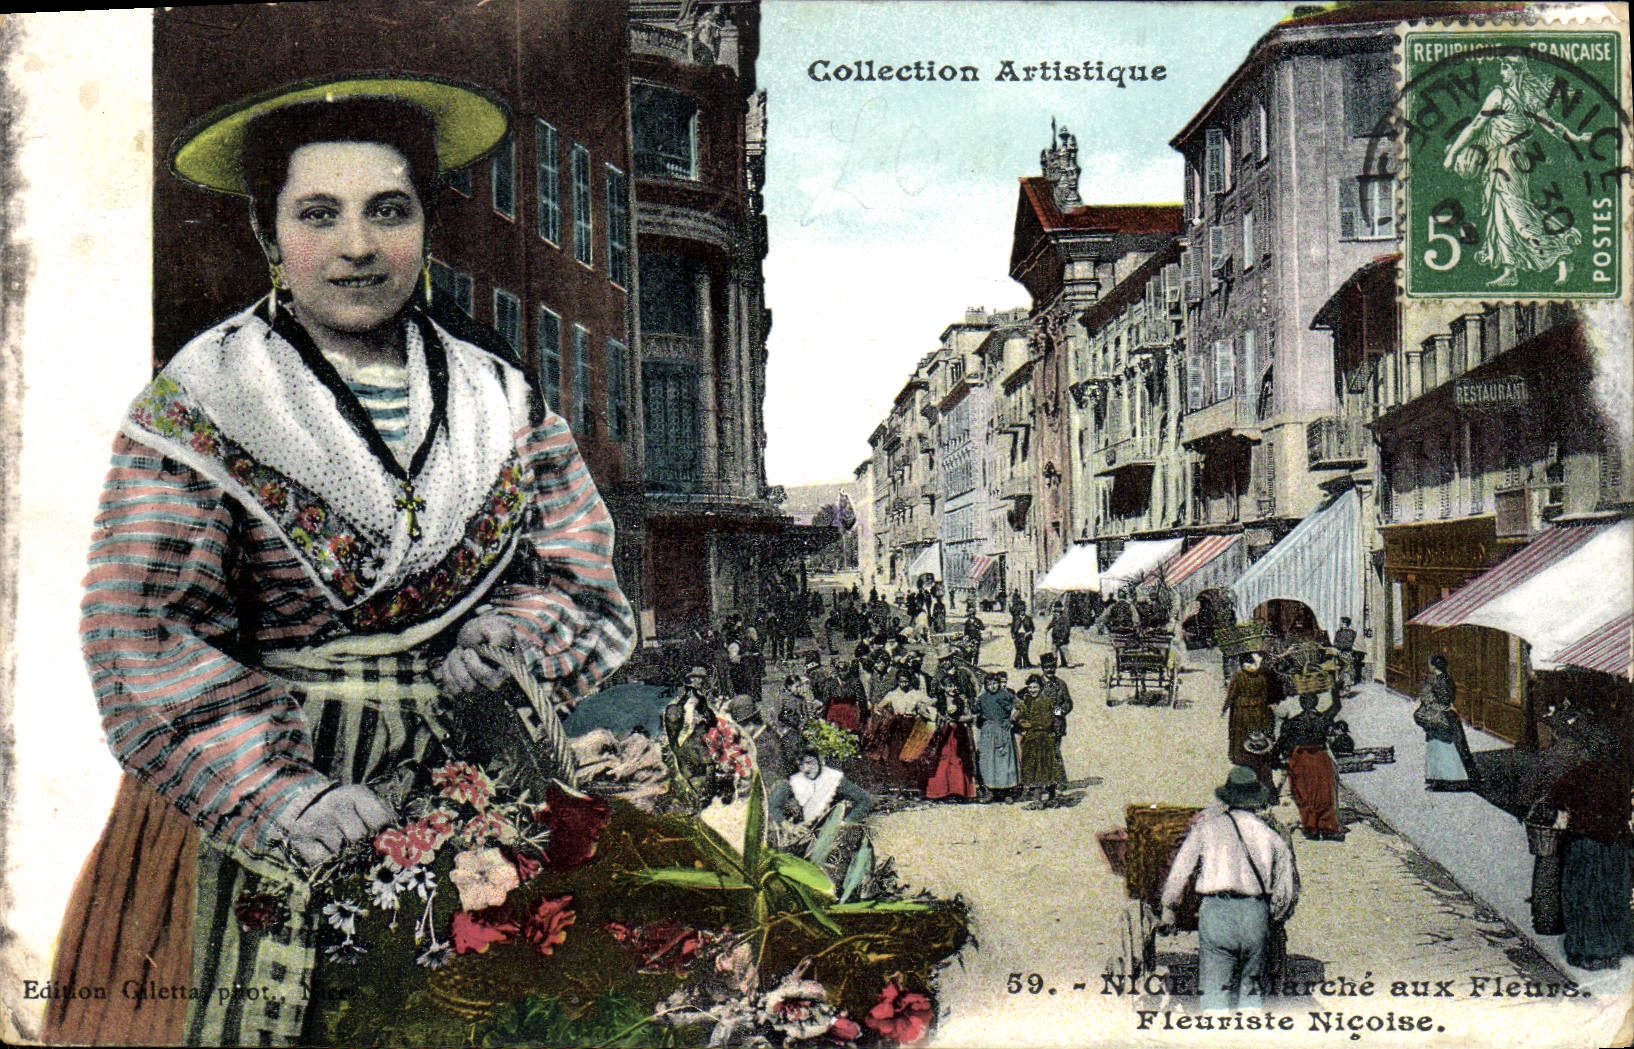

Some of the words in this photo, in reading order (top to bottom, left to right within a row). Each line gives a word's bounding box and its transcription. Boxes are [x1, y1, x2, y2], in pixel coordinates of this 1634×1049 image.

[1530, 42, 1612, 64] FRANÇAISE
[1423, 215, 1462, 271] 5
[1592, 197, 1612, 283] POSTES
[1456, 382, 1529, 404] RESTAURANT
